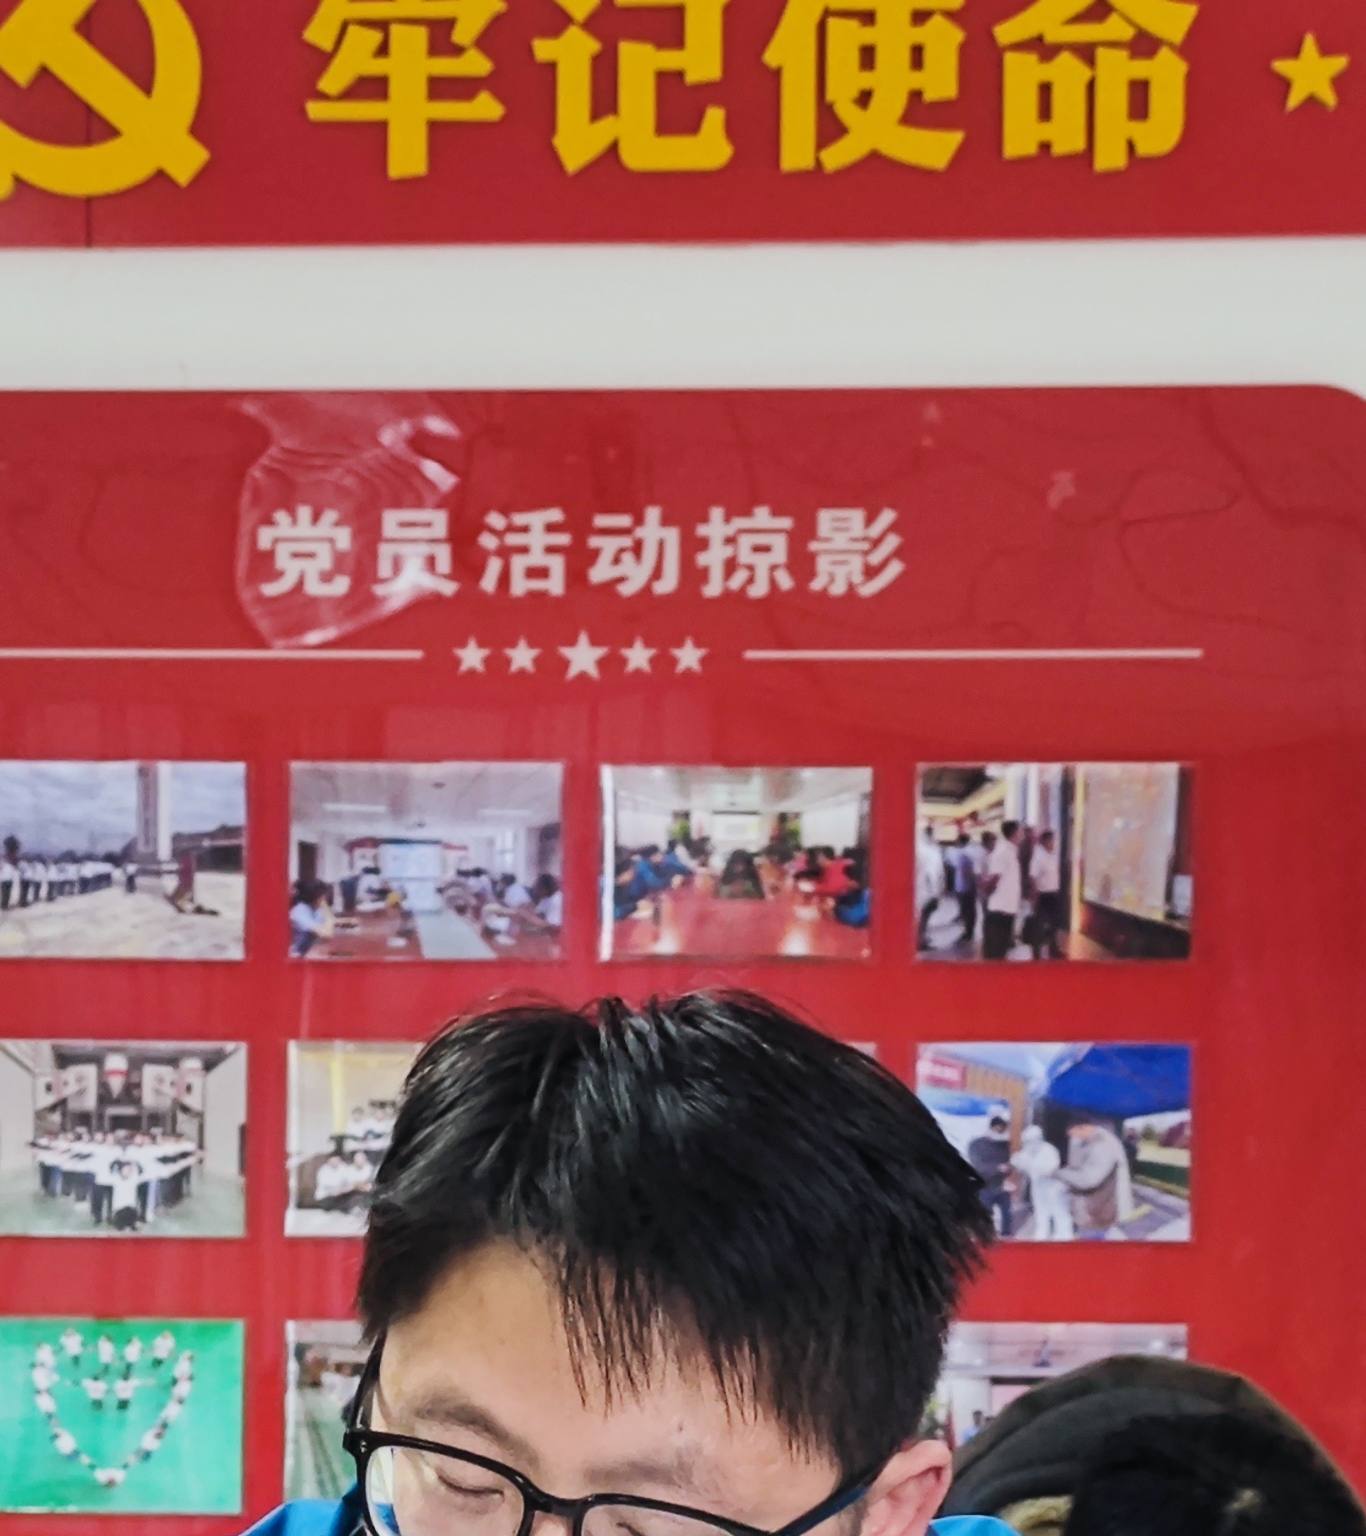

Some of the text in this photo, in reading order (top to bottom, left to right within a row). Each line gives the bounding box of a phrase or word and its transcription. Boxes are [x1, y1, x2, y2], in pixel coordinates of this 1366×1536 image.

[304, 0, 1190, 180] 牢记使命
[255, 503, 908, 602] 党员活动掠影
